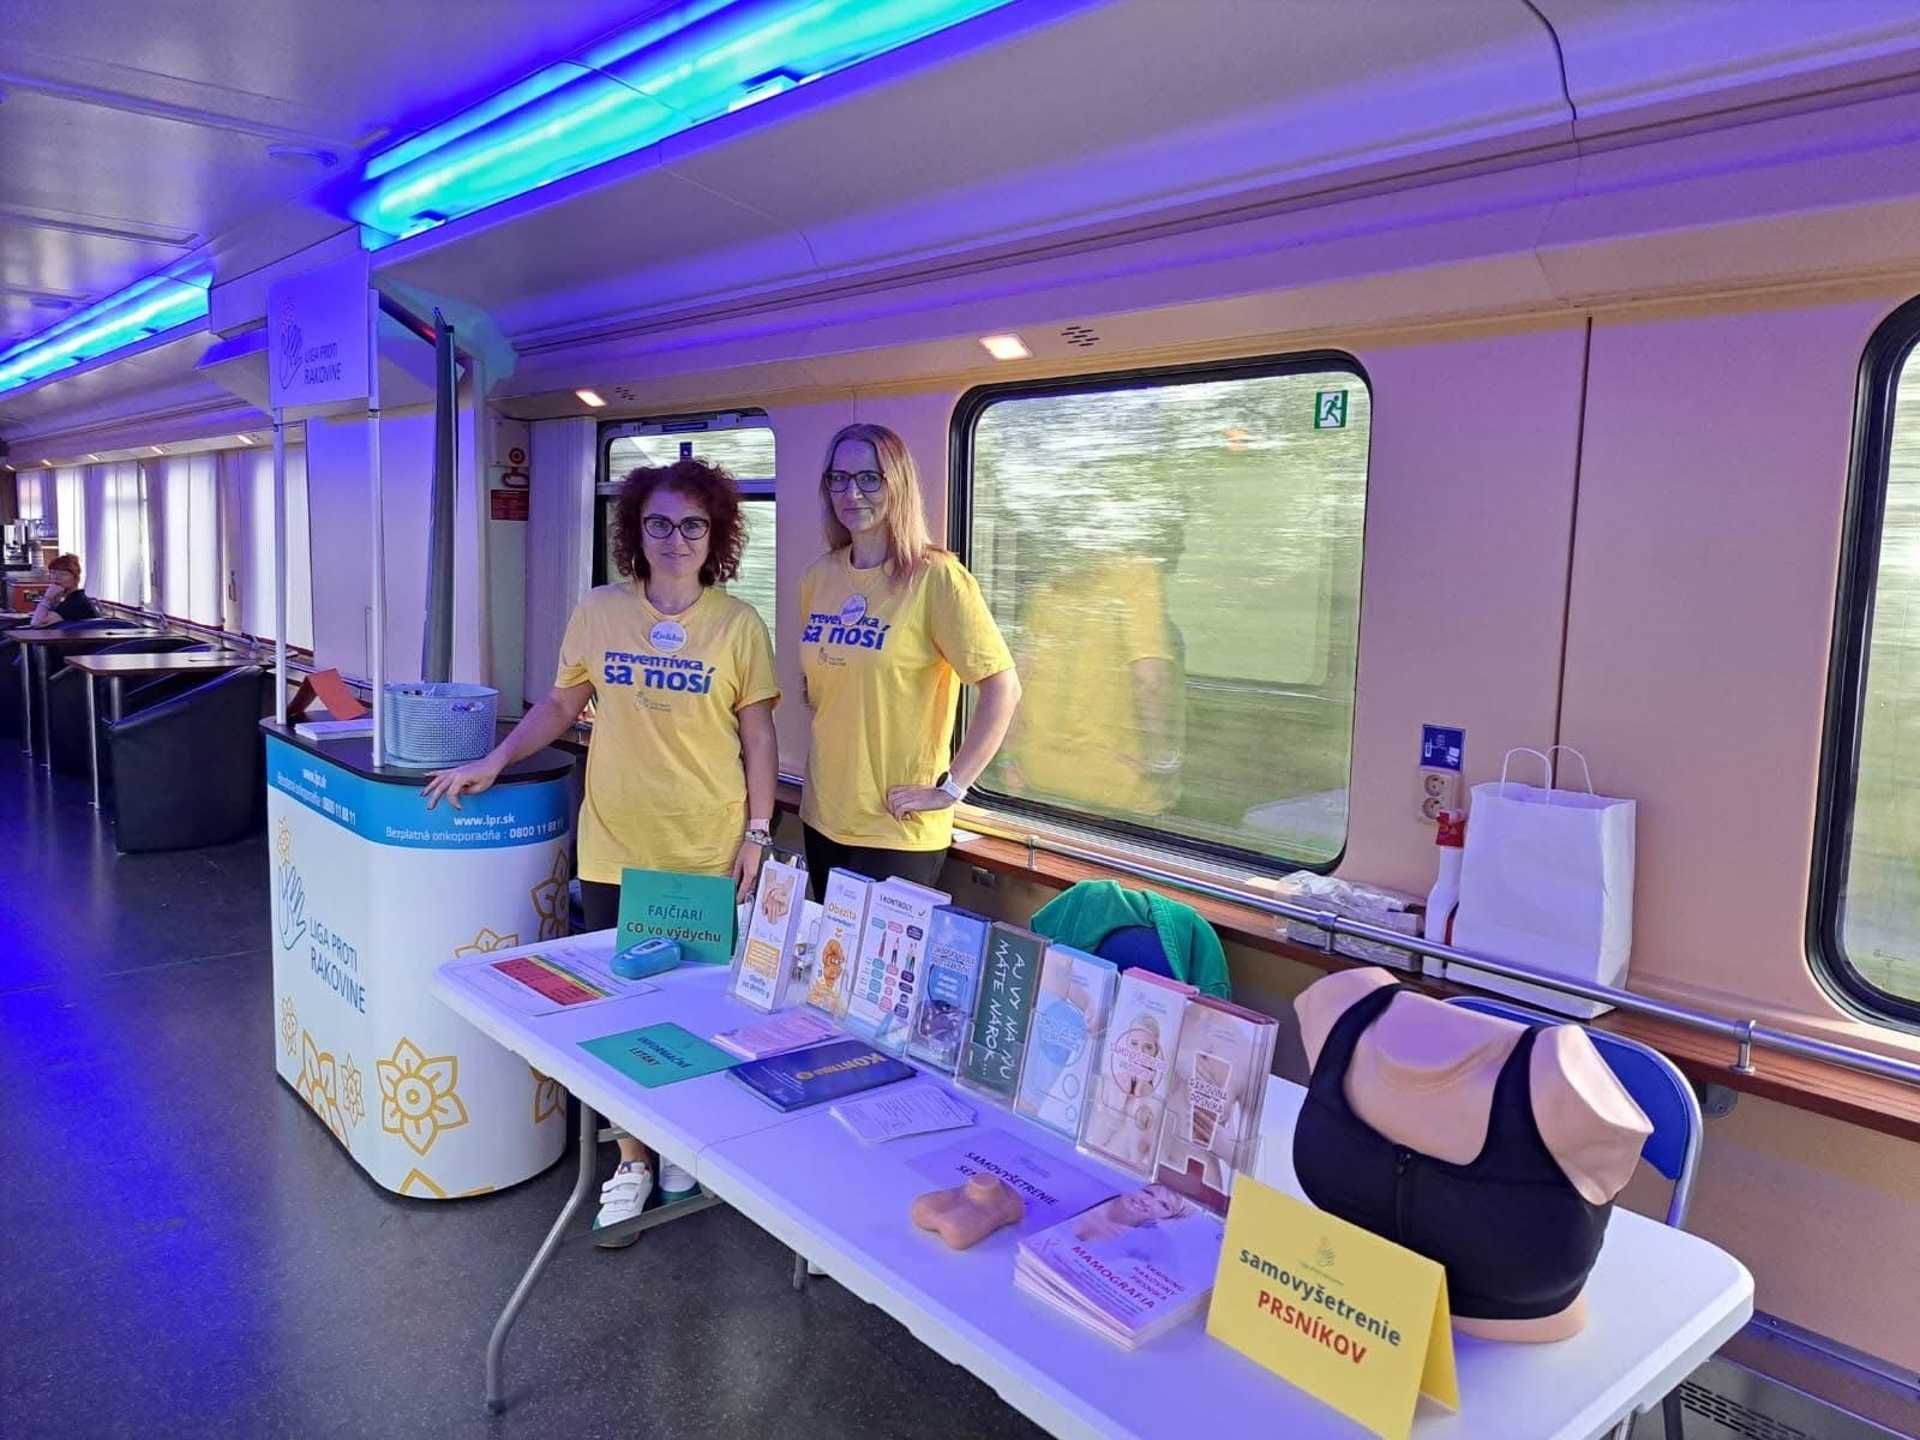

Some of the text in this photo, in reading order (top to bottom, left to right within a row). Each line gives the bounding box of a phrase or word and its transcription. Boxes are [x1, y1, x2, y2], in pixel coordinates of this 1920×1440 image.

[828, 624, 891, 650] nosí
[604, 664, 716, 694] sa nosí
[385, 825, 431, 841] Bezplatná
[509, 825, 535, 839] 0800
[454, 813, 516, 827] www.lpr.sk
[648, 904, 703, 921] FAJČIARI
[310, 917, 358, 972] LIGA PROTI
[626, 921, 721, 942] CO vo výdychu
[1011, 952, 1025, 979] AJ
[311, 946, 365, 1014] RAKOVINE
[1009, 986, 1022, 1010] VY
[1004, 1015, 1018, 1042] NA
[965, 1152, 1059, 1206] SAMOVYŠETRENIE
[1072, 1246, 1154, 1309] MAMOGRAFIA
[1239, 1248, 1402, 1347] samovyšetrenie
[1258, 1290, 1367, 1364] PRSNÍKOV
